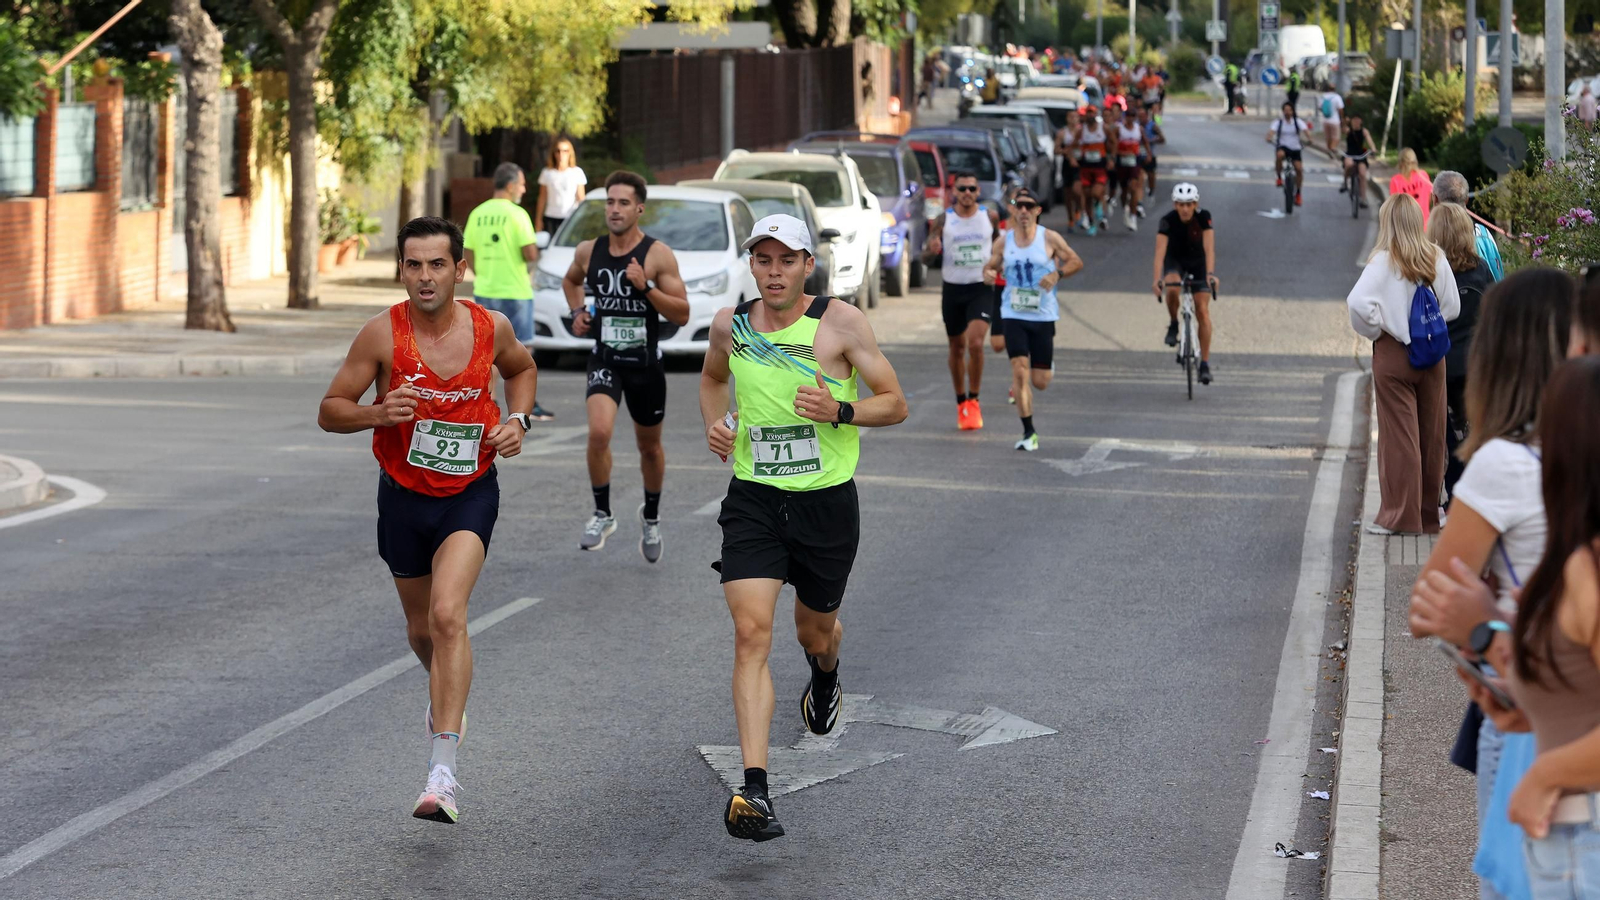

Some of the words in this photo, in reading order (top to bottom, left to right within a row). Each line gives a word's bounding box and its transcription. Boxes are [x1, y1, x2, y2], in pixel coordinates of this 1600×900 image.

[613, 328, 636, 340] 108
[436, 439, 460, 458] 93
[770, 443, 793, 461] 71
